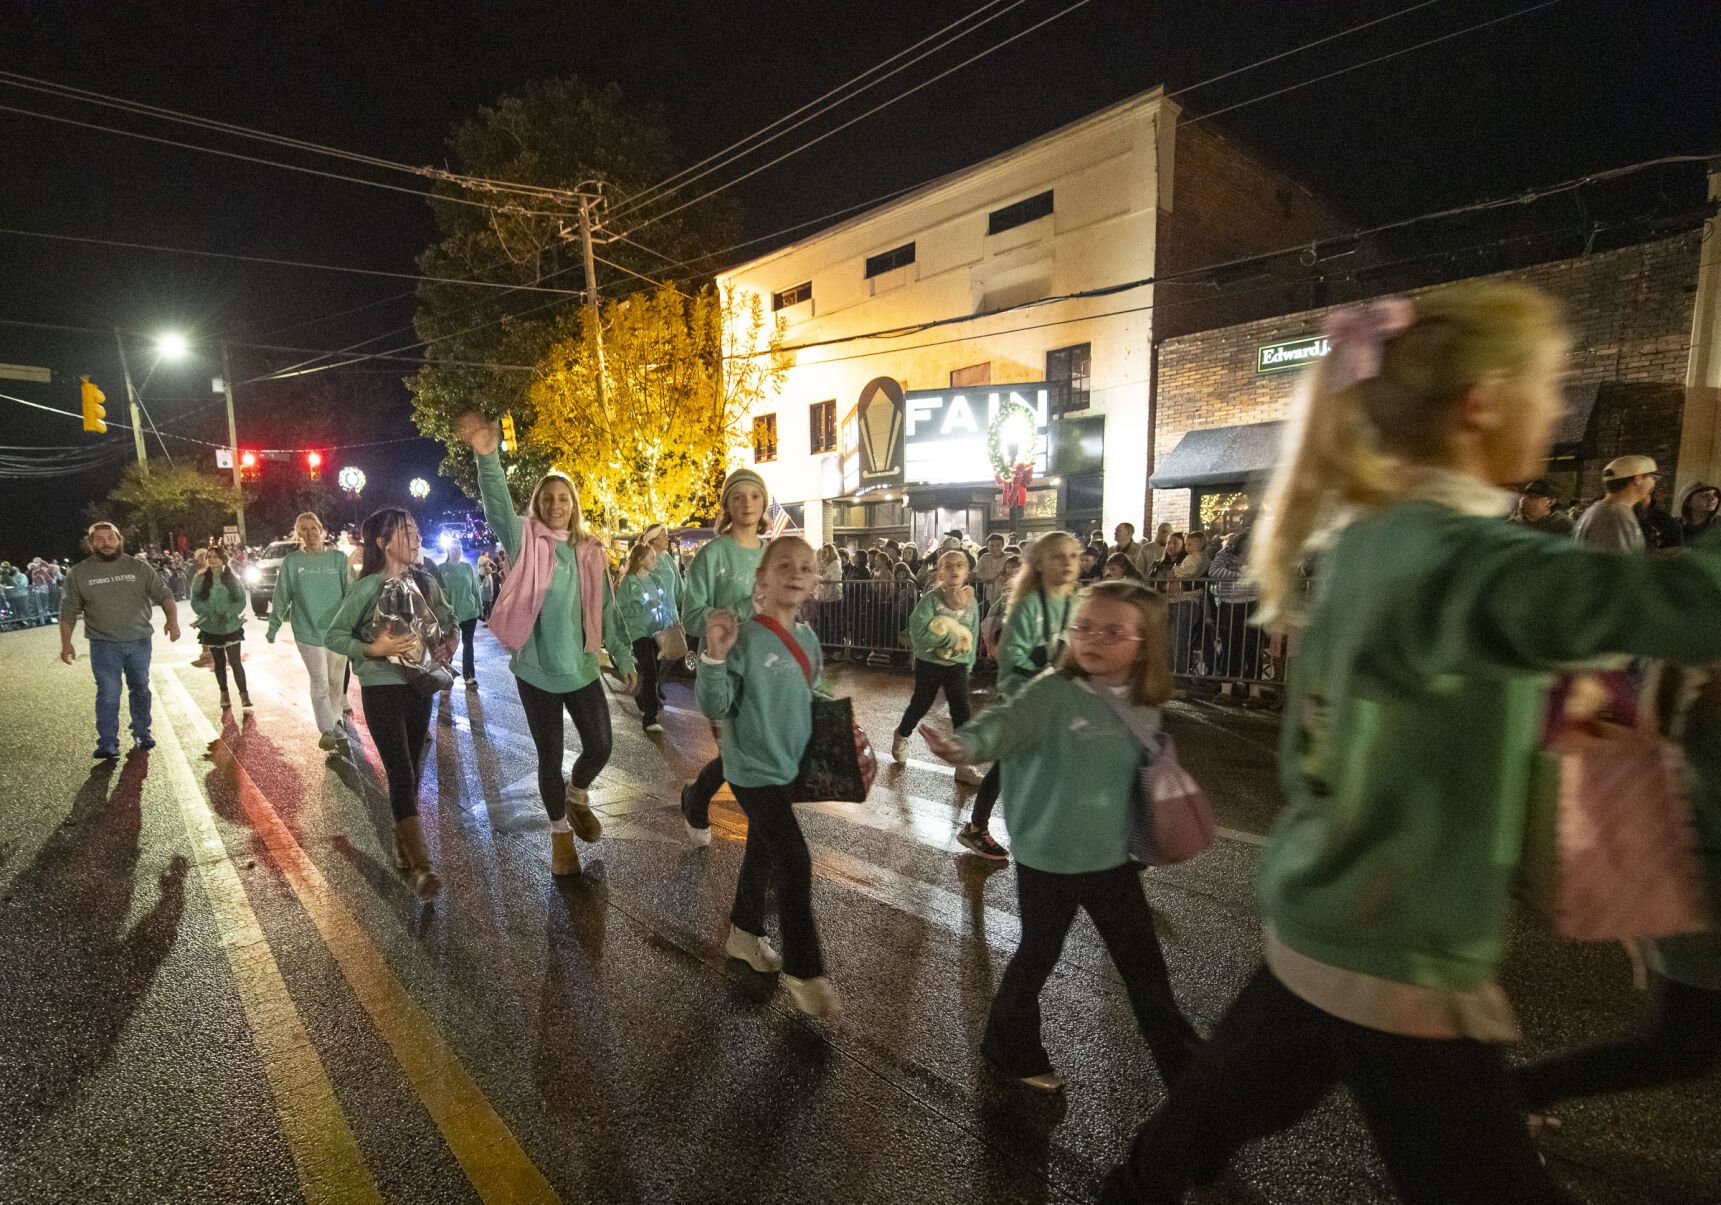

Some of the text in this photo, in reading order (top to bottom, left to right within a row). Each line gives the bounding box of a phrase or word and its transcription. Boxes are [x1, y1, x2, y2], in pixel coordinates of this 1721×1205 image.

[1261, 340, 1320, 365] Edward
[905, 389, 1048, 437] FAIN
[87, 577, 110, 586] STUDIO
